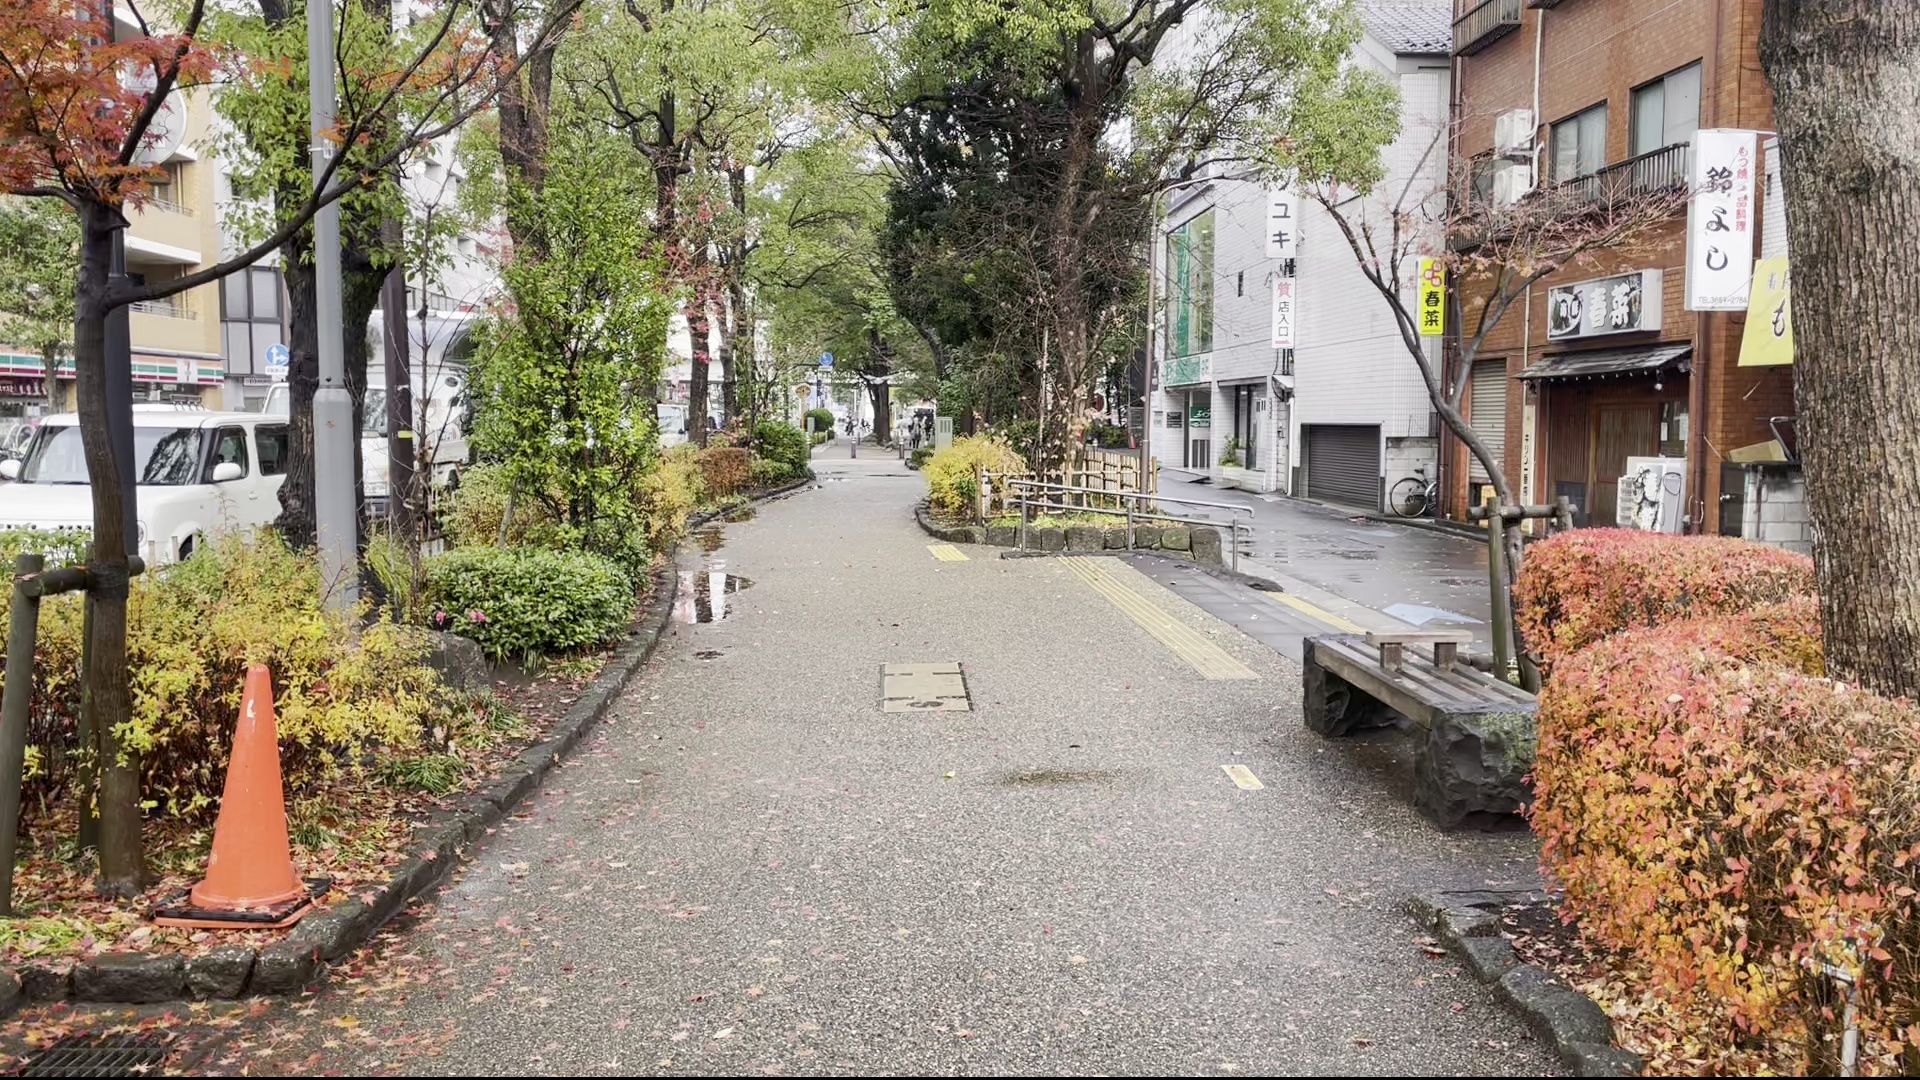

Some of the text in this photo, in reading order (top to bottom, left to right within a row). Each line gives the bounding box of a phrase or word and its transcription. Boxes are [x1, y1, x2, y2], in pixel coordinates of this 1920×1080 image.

[1272, 203, 1291, 249] ユキ
[1277, 281, 1292, 337] 質店入口
[1424, 290, 1440, 327] 春菜
